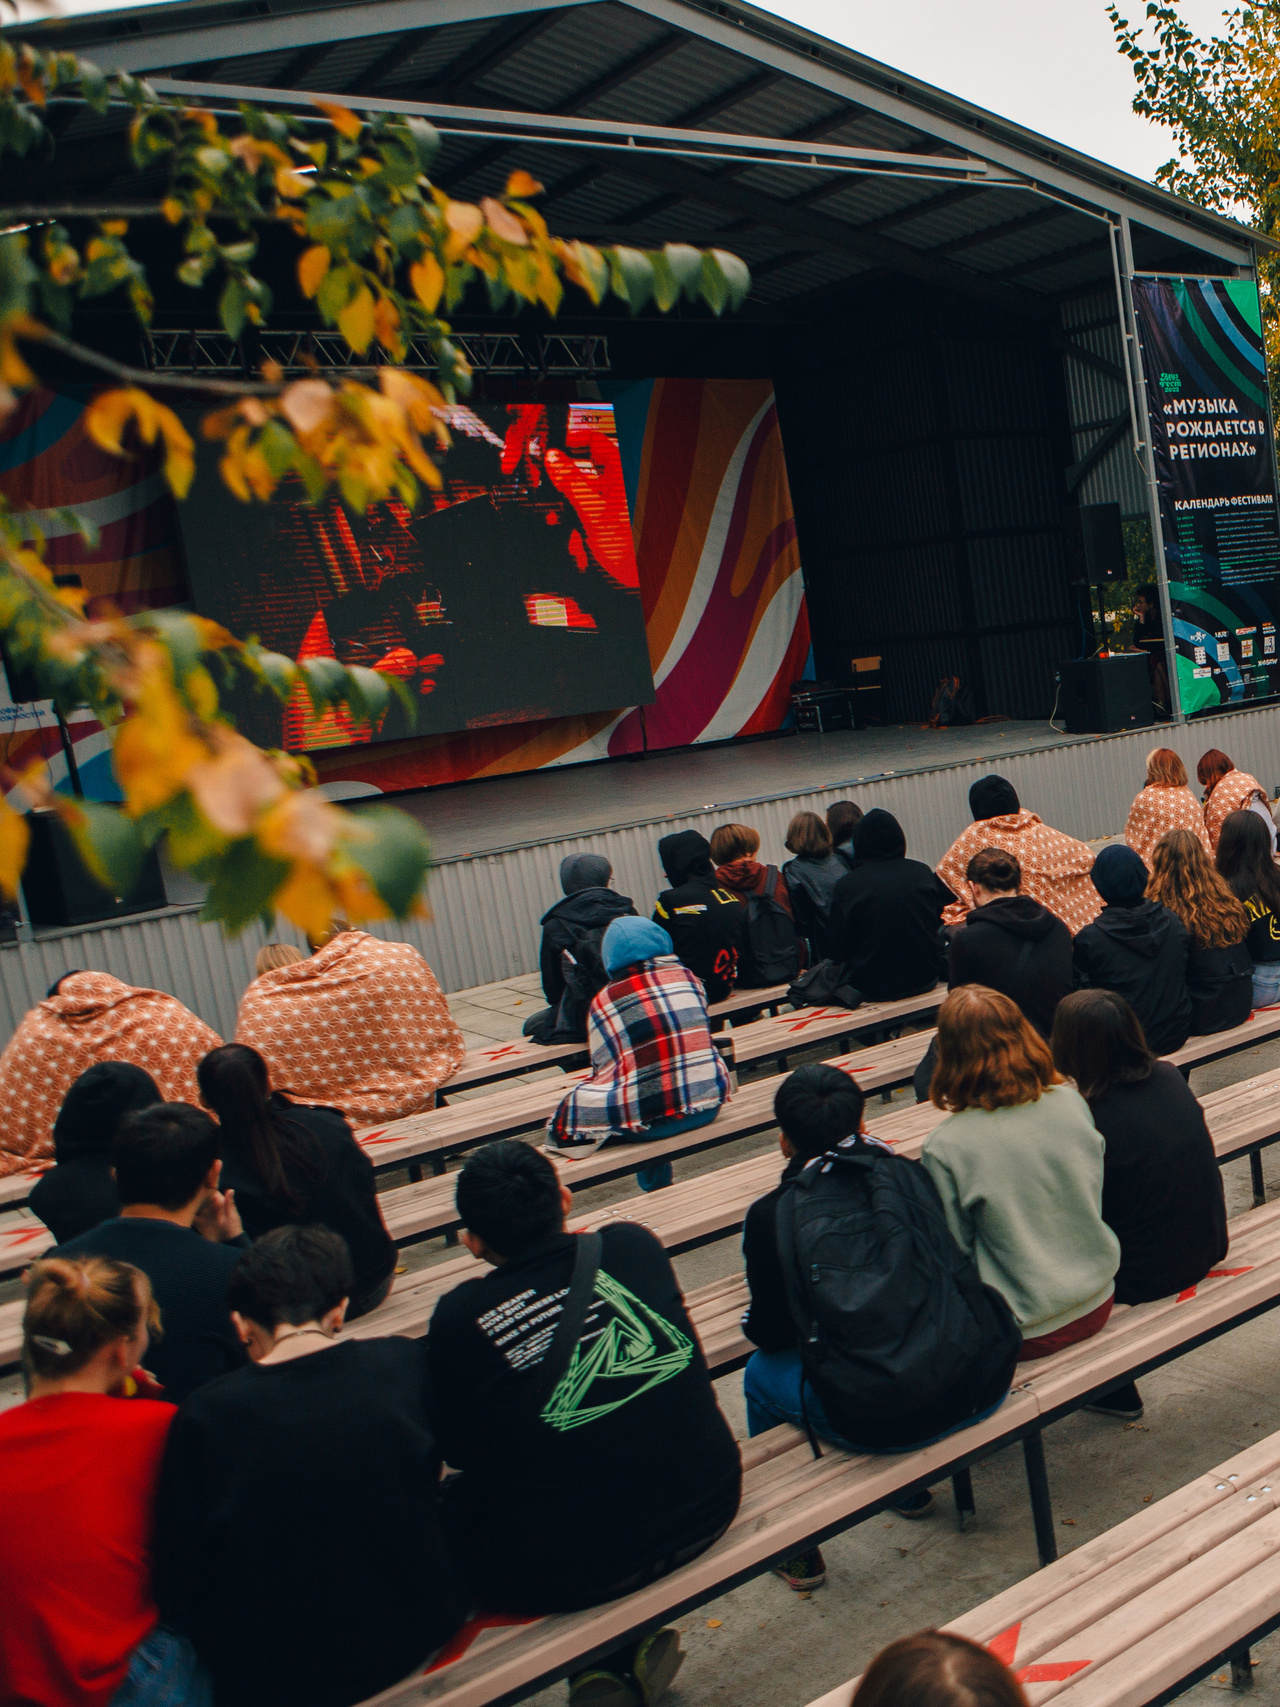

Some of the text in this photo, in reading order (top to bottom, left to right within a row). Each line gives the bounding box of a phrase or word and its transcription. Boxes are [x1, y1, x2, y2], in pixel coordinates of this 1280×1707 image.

[1163, 398, 1238, 415] «МУЗЫКА
[1166, 420, 1265, 438] РОЖДАЕТСЯ В
[1169, 441, 1257, 460] РЕГИОНАХ»
[1174, 494, 1273, 511] КАЛЕНДАРЬ ФЕСТИВАЛЯ
[493, 1317, 515, 1333] 2020
[513, 1295, 555, 1320] CHINESE
[503, 1301, 525, 1316] SHIT
